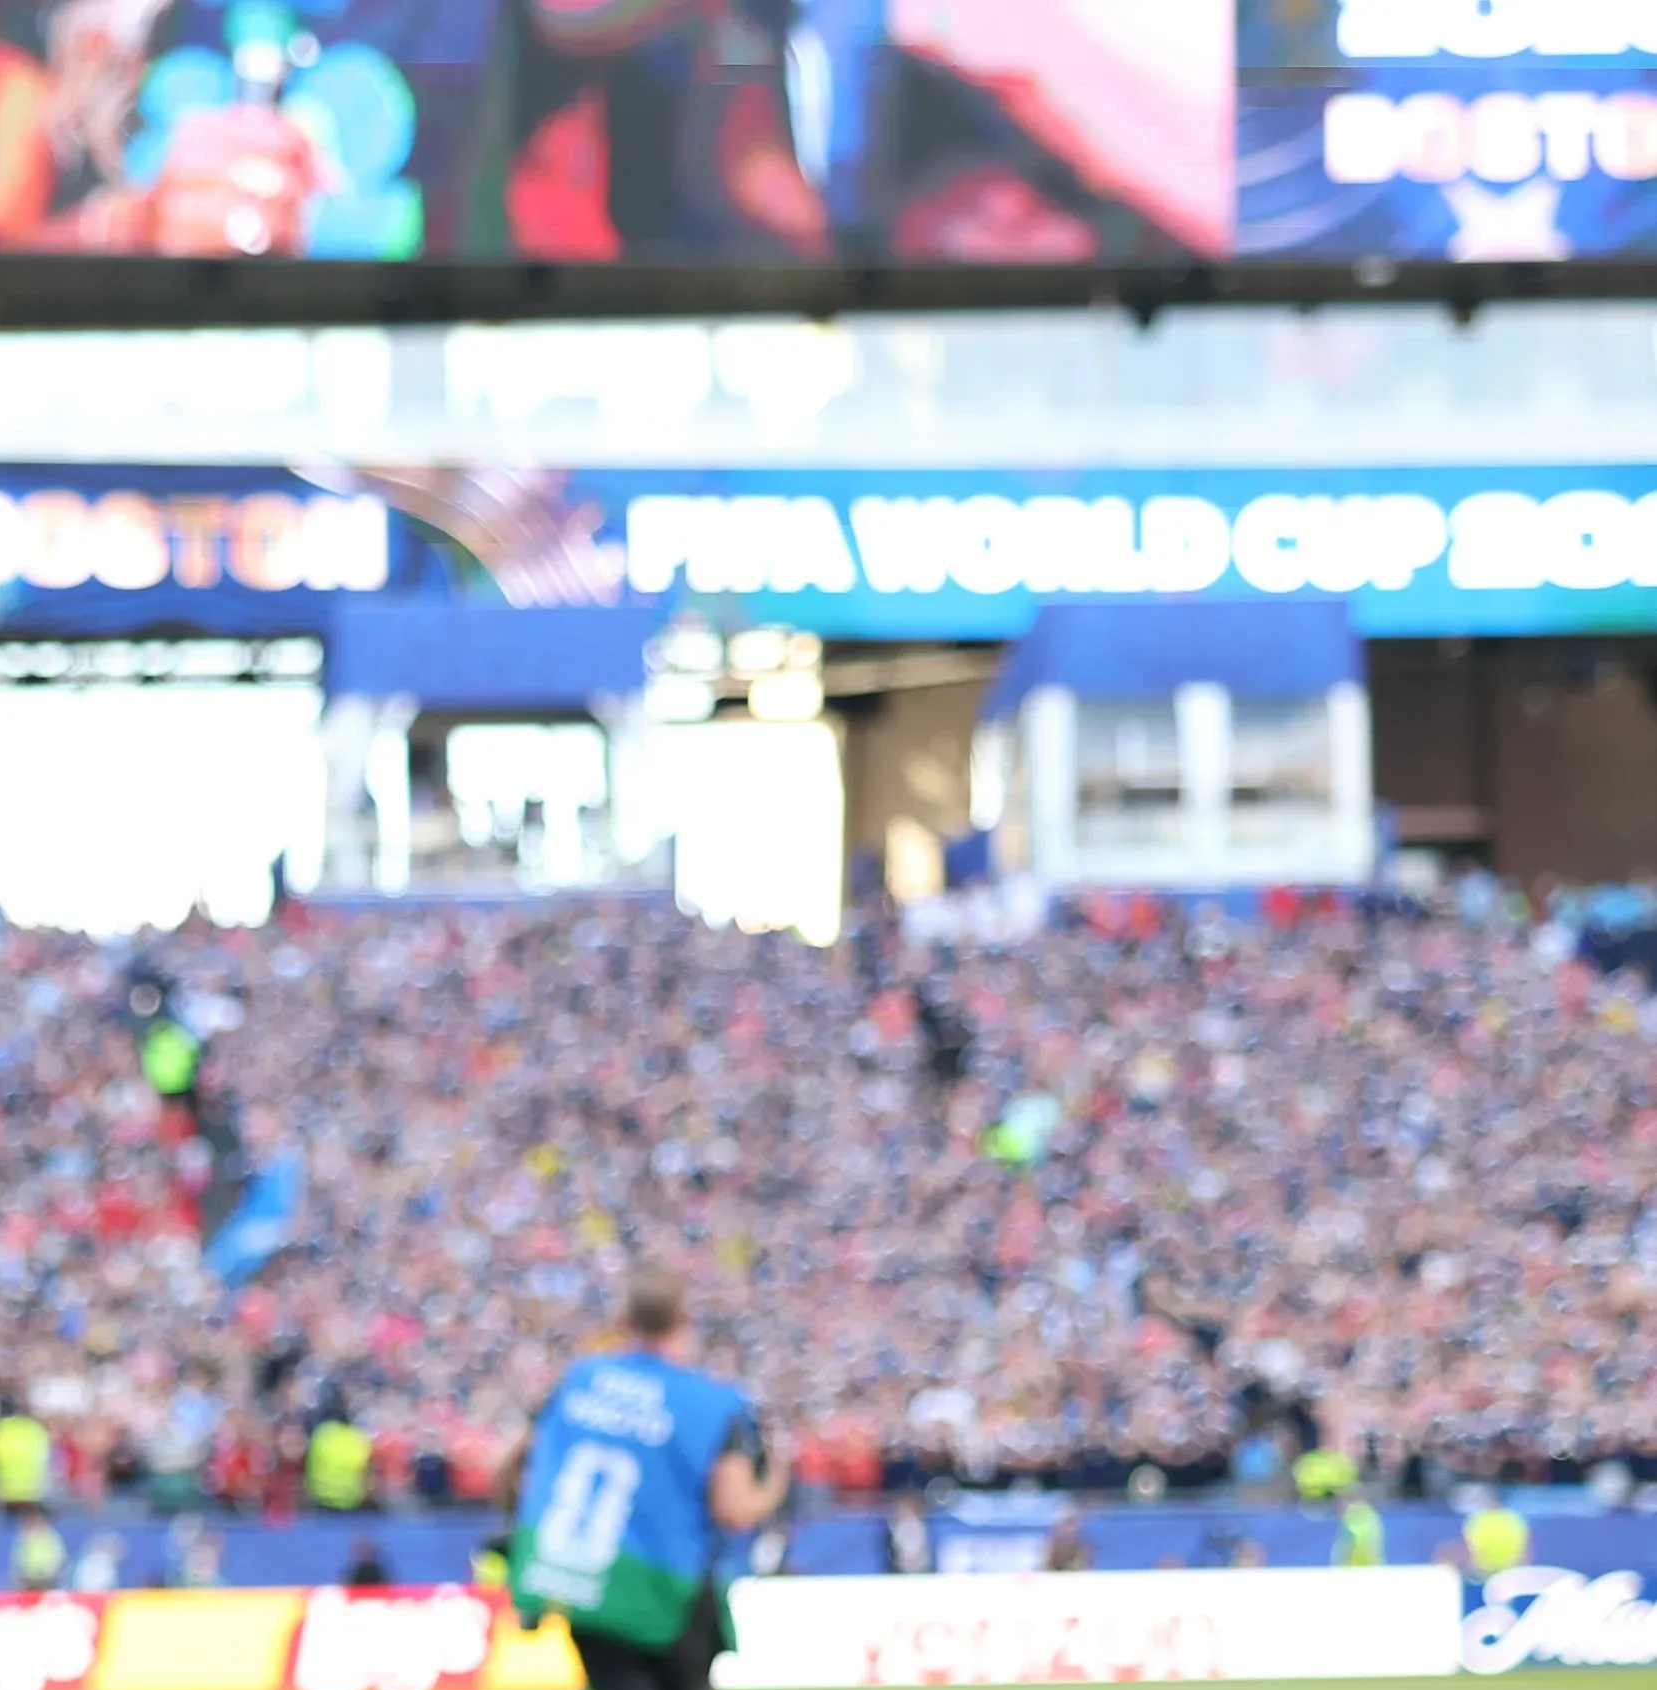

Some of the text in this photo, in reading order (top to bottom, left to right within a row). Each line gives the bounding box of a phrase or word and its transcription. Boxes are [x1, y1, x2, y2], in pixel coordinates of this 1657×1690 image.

[627, 495, 856, 593] FIFA
[850, 493, 1231, 594] WORLD
[1233, 493, 1448, 592] CUP
